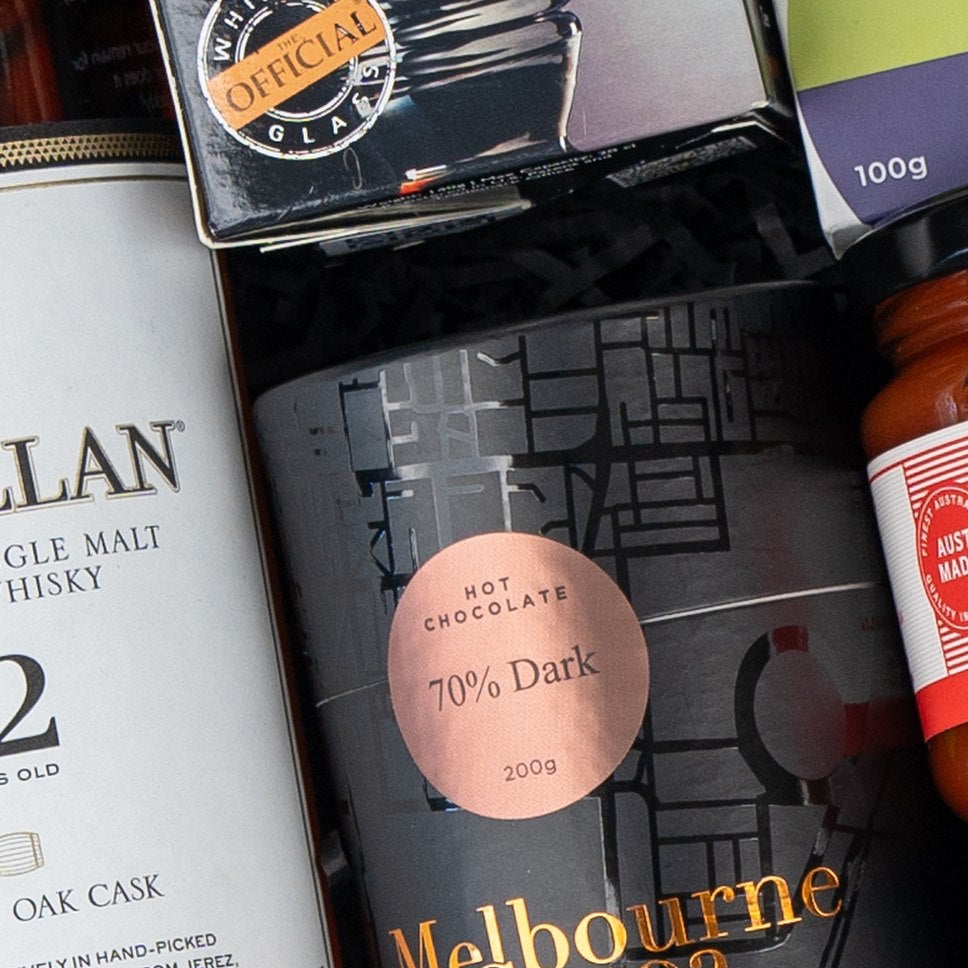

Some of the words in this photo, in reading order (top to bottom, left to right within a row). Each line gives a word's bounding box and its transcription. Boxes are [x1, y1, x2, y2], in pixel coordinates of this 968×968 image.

[225, 11, 377, 113] OFFICIAL
[277, 33, 299, 51] THE
[268, 65, 379, 144] GLASS
[853, 152, 929, 188] 100g
[0, 420, 181, 515] LAN
[4, 537, 70, 569] GLE
[83, 525, 160, 557] MALT
[0, 565, 102, 603] HISKY
[464, 577, 511, 600] HOT
[925, 574, 957, 621] QUALITY
[424, 586, 568, 631] CHOCOLATE
[428, 666, 500, 712] 70%
[506, 645, 600, 692] Dark
[0, 654, 60, 757] 2
[17, 763, 60, 781] OLD
[503, 758, 557, 782] 200g
[13, 889, 79, 921] OAK
[88, 874, 165, 907] CASK
[72, 954, 92, 968] IN
[96, 933, 217, 964] HAND-PICKED
